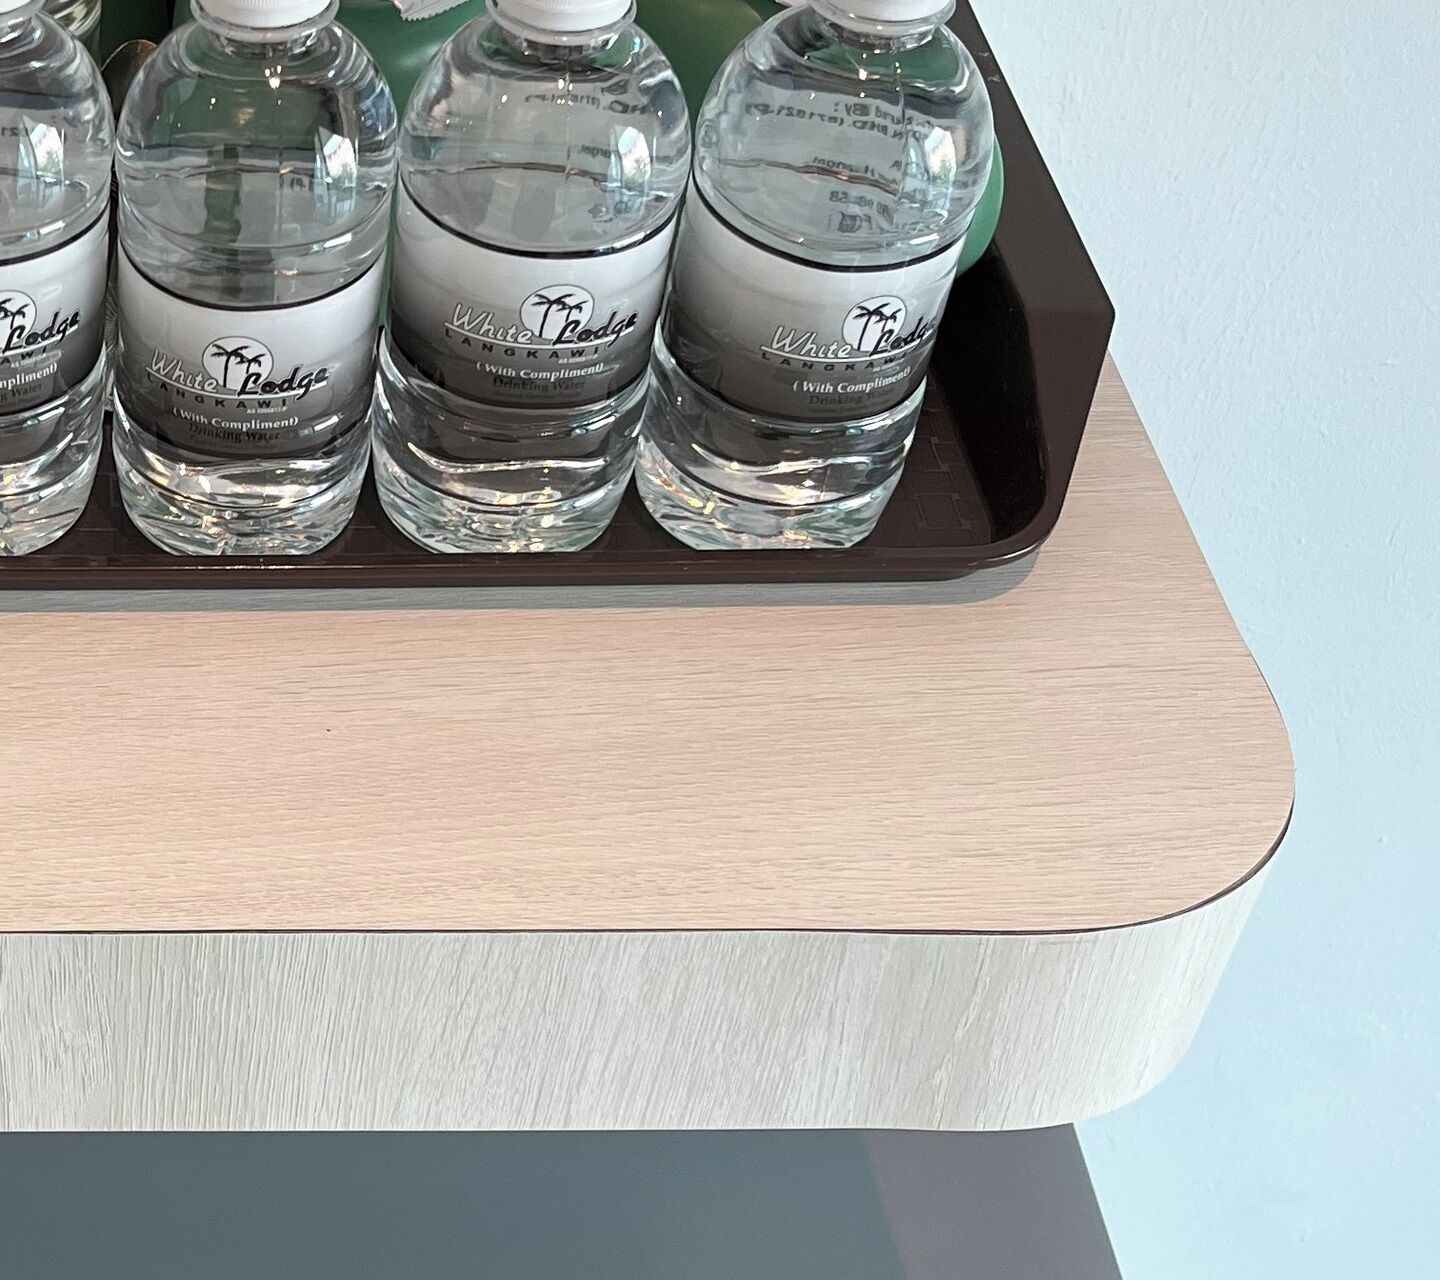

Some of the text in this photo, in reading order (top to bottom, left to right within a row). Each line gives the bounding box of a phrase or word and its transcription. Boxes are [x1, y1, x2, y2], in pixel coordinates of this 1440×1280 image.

[1, 308, 80, 355] Lodge
[452, 302, 639, 348] White Lodge
[771, 324, 853, 359] White
[444, 326, 601, 360] LANGKAWI
[150, 349, 330, 401] White Lodge
[519, 361, 605, 382] Compliment)
[761, 350, 909, 373] LANGKAWI
[146, 372, 288, 410] LANGKAWI
[836, 365, 912, 394] Compliment)
[211, 415, 299, 432] Compliment)
